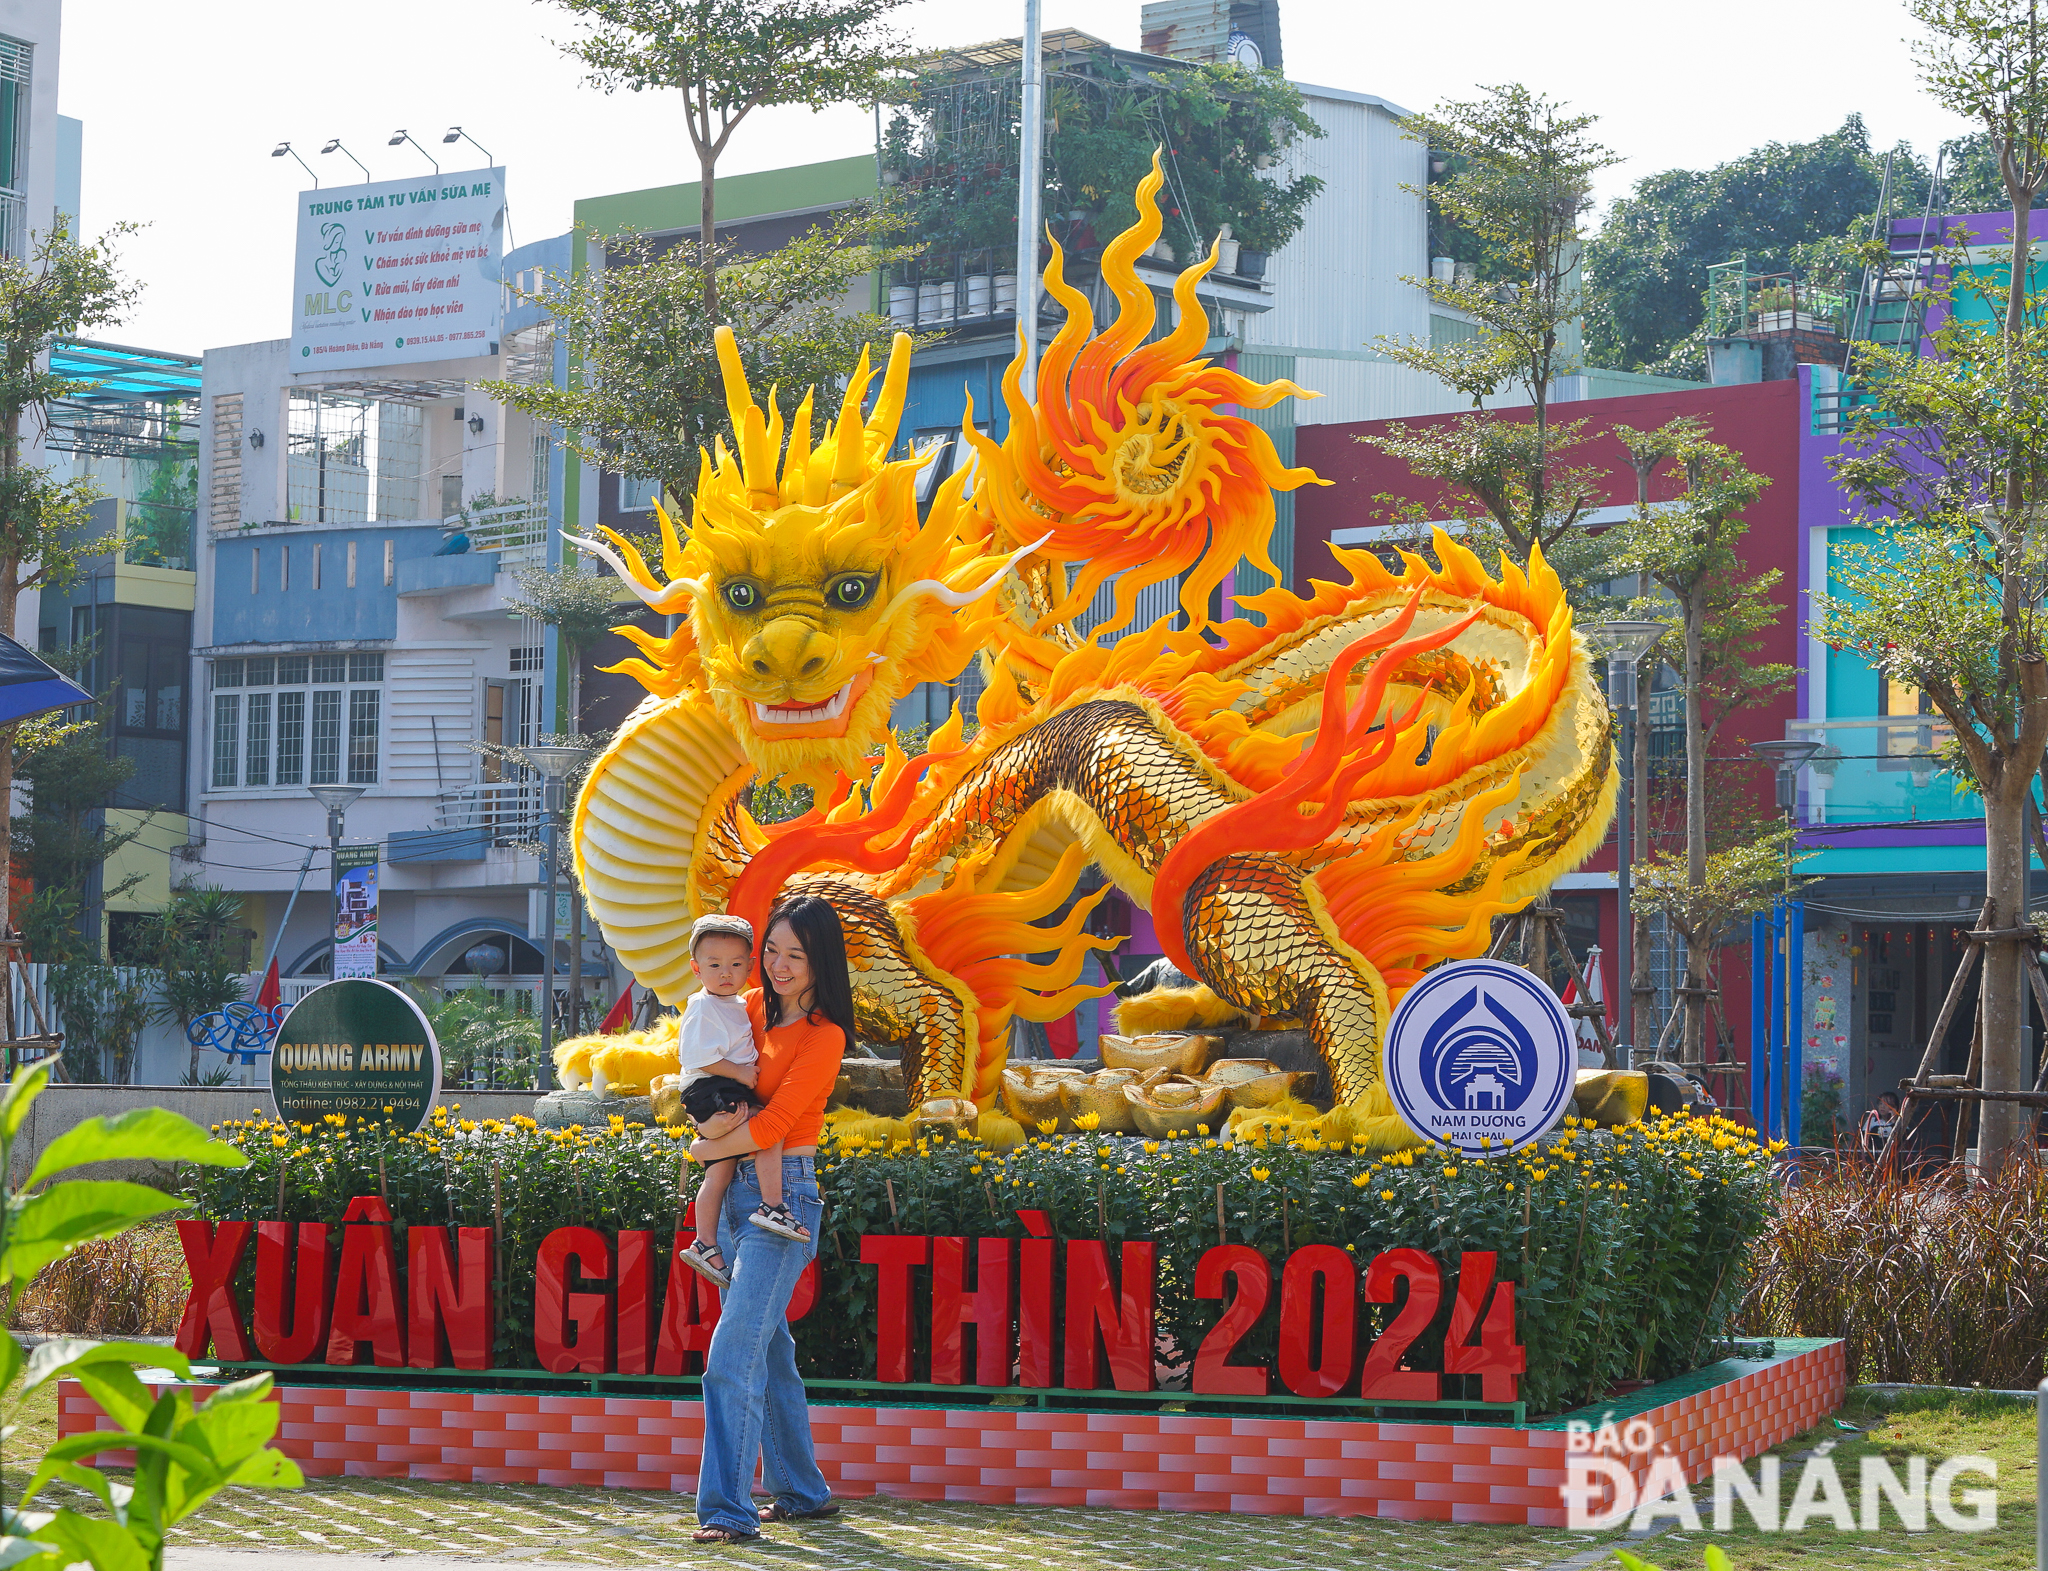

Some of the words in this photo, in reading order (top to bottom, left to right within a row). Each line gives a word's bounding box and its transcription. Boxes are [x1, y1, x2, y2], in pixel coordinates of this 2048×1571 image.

[309, 200, 353, 216] TRUNG
[357, 195, 384, 210] TÂM
[388, 193, 406, 206] TƯ
[409, 186, 436, 204] VẤN
[471, 182, 491, 198] MẸ
[377, 231, 388, 244] Tư
[388, 225, 403, 242] vấn
[452, 222, 467, 235] sữa
[469, 222, 481, 236] mẹ
[376, 255, 398, 269] Chăm
[400, 253, 413, 267] sóc
[415, 251, 428, 265] sức
[430, 247, 450, 264] khoẻ
[451, 250, 464, 263] mẹ
[465, 246, 476, 259] và
[477, 244, 489, 258] bé
[375, 282, 391, 296] Rửa
[411, 276, 425, 294] lấy
[304, 290, 353, 316] MLC
[374, 308, 395, 324] Nhận
[415, 306, 428, 320] tạo
[430, 303, 445, 319] học
[446, 300, 464, 314] viên
[280, 1043, 353, 1074] QUANG
[359, 1044, 424, 1072] ARMY
[282, 1096, 332, 1109] Hotline:
[1431, 1115, 1466, 1127] NAM
[1471, 1115, 1526, 1127] DƯƠNG
[174, 1196, 494, 1370] XUÂN
[860, 1210, 1158, 1392] THÌN
[1193, 1244, 1527, 1403] 2024
